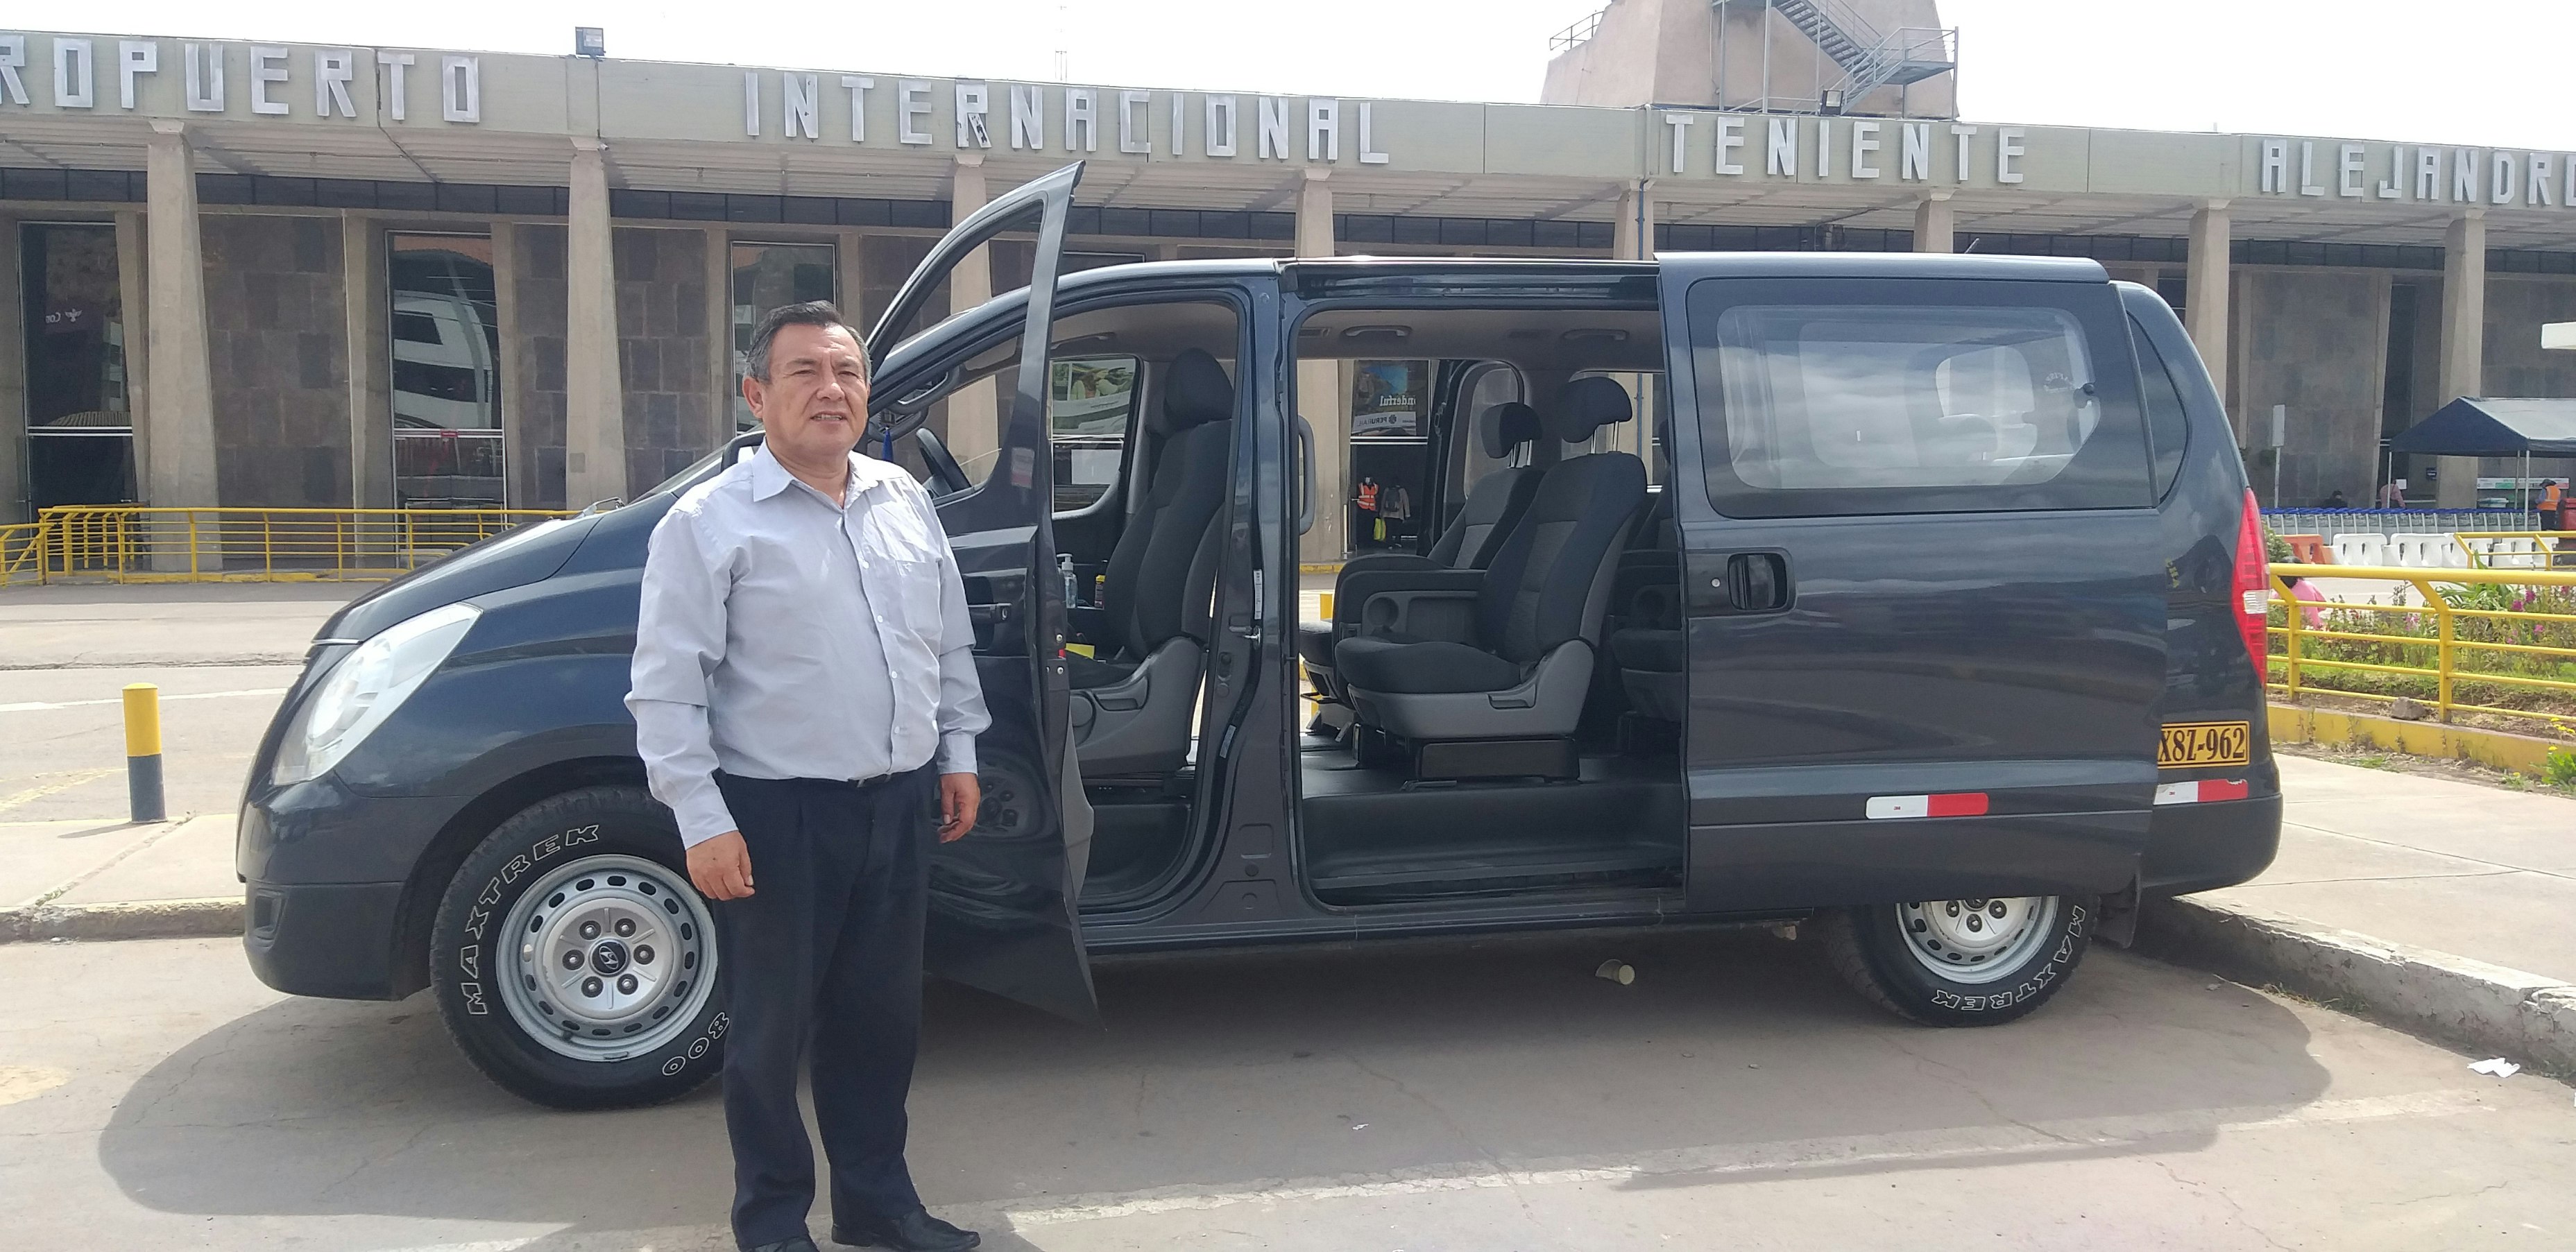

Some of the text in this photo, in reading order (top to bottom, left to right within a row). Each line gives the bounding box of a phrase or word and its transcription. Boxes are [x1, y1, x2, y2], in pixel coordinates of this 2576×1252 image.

[745, 71, 1390, 164] INTERNACIONAL
[1666, 114, 2025, 183] TENIENTE
[2158, 727, 2246, 762] X8Z-962
[460, 824, 600, 1016] MAXTREK
[1931, 905, 2086, 1011] MAXTREK
